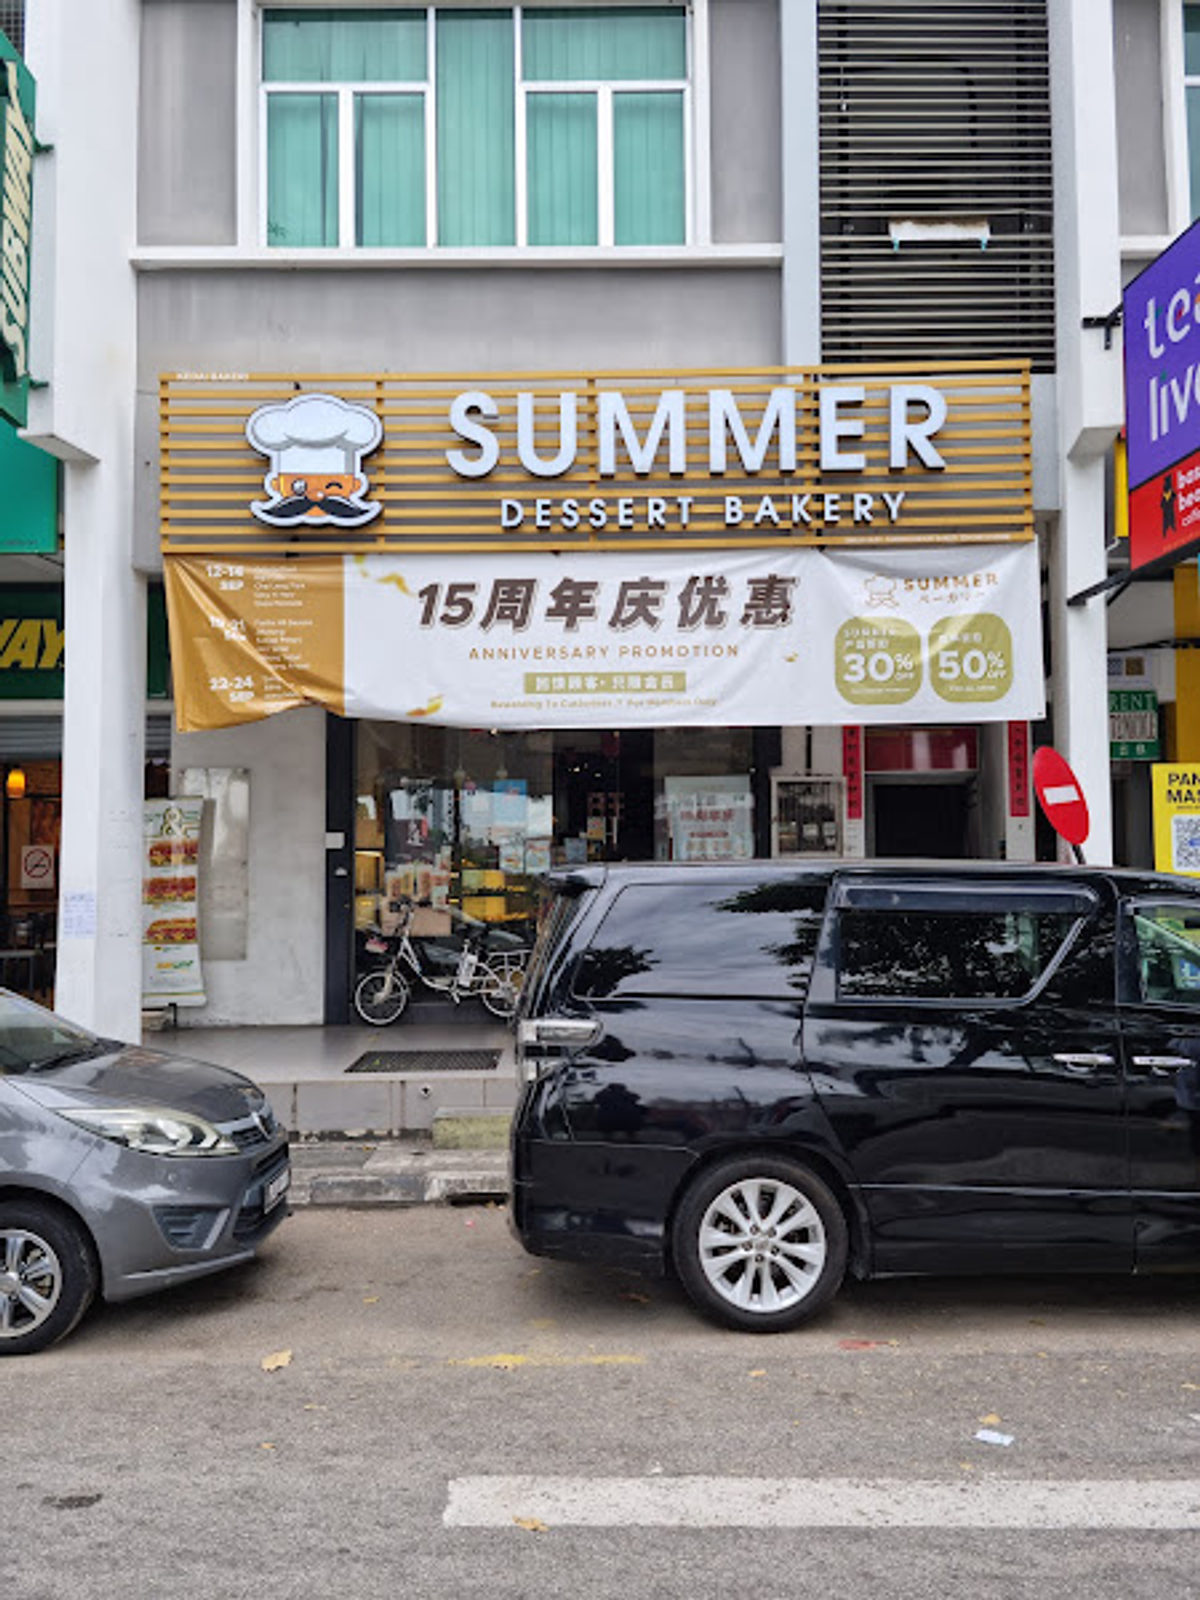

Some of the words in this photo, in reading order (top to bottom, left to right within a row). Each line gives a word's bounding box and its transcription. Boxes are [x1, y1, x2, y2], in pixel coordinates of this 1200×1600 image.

[2, 62, 32, 377] SUBWAY
[1144, 271, 1200, 359] te
[446, 384, 948, 478] SUMMER
[1150, 362, 1200, 442] liv
[500, 496, 694, 530] DESSERT
[725, 491, 906, 528] BAKERY
[417, 573, 799, 632] 15周年庆优惠
[903, 573, 999, 591] SUMMER
[468, 646, 610, 660] ANNIVERSARY
[618, 643, 739, 659] PROMOTION
